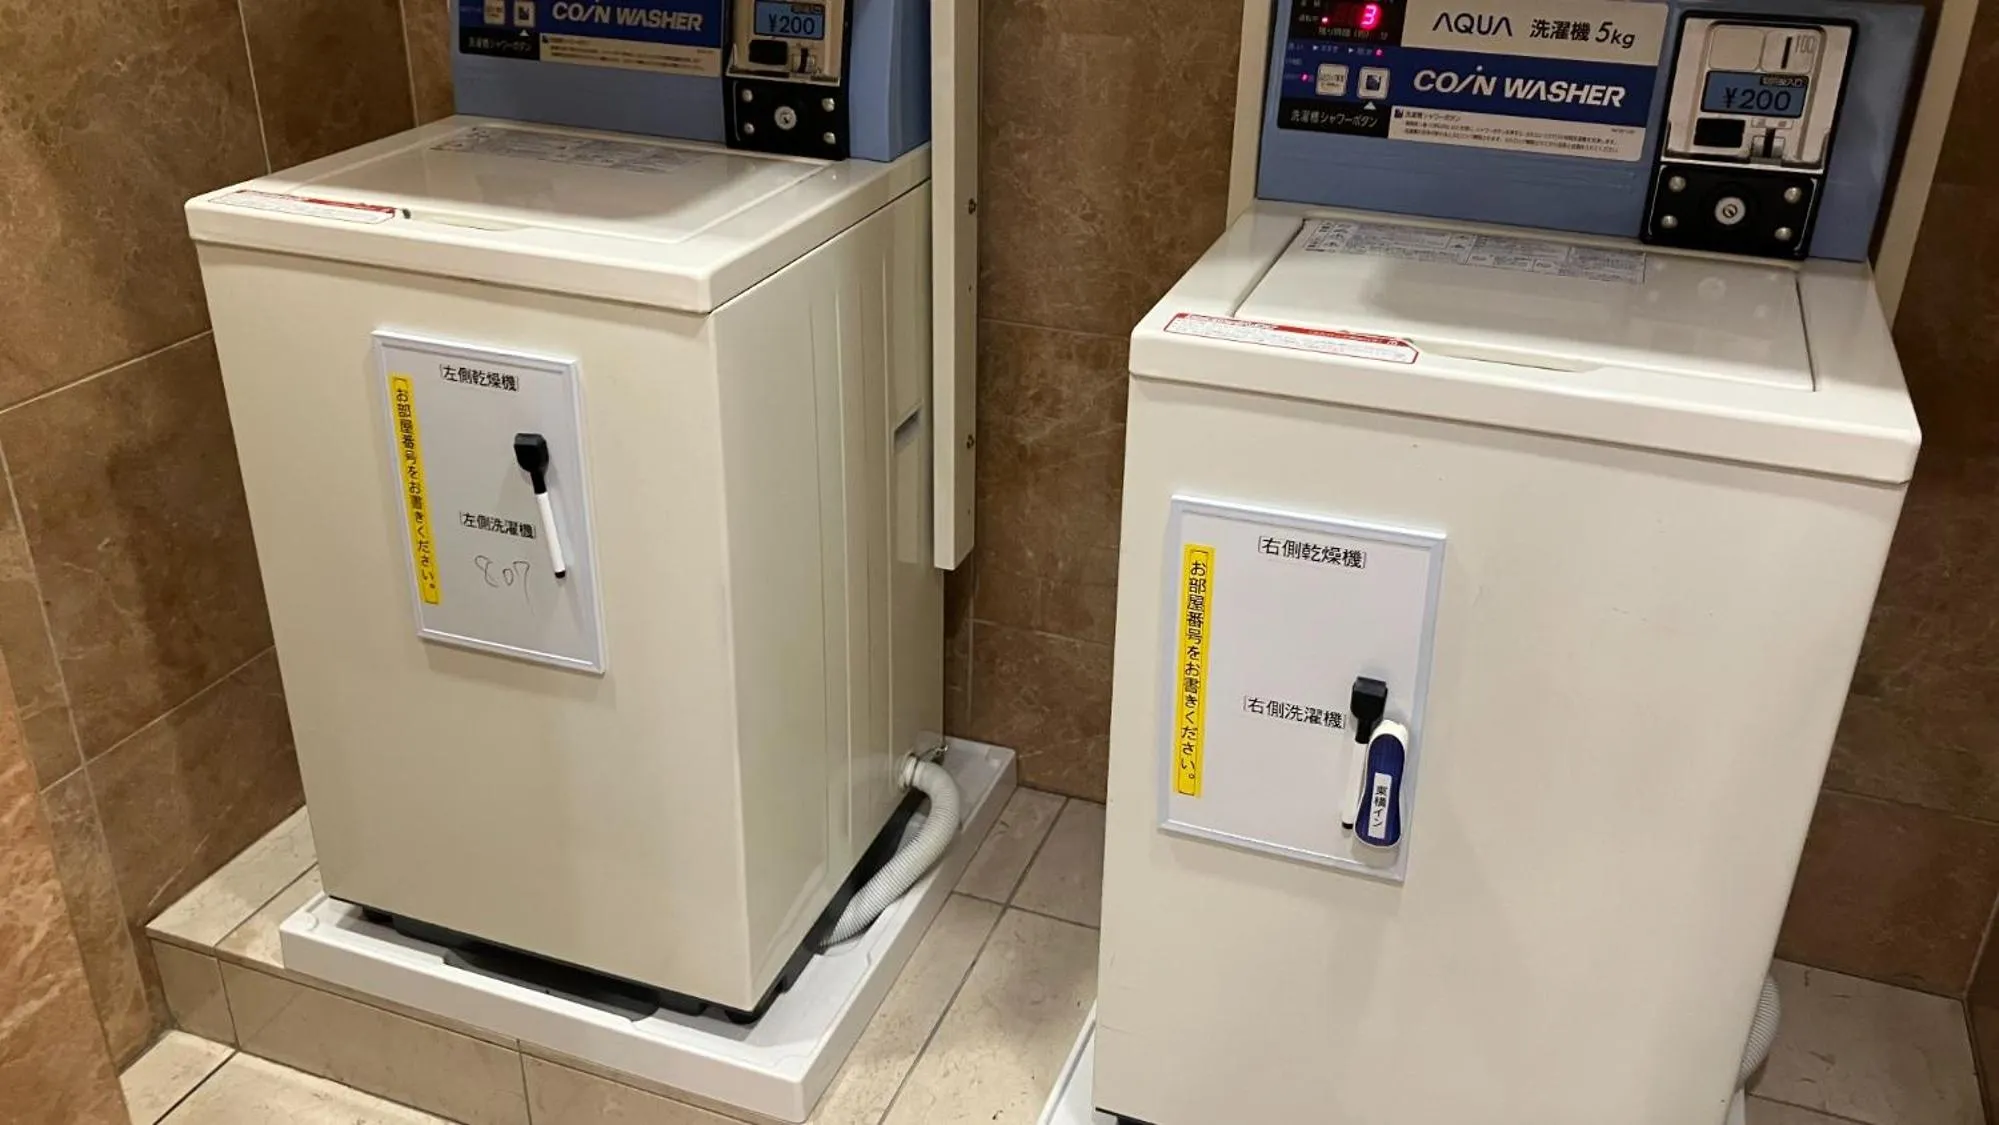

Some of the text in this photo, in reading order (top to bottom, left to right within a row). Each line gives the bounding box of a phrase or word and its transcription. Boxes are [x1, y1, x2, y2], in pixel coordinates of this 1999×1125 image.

[617, 7, 704, 31] WASHER
[769, 14, 815, 35] ¥200
[1361, 4, 1379, 26] 3
[1432, 12, 1513, 37] AQUA
[1529, 19, 1636, 48] 洗濯機 5kg
[1503, 77, 1626, 108] WASHER
[1721, 86, 1792, 111] ¥200
[443, 364, 517, 391] 左側乾燥機
[396, 388, 435, 590] お部屋番号をお書きください。
[463, 512, 534, 539] 左側洗濯機
[1261, 536, 1364, 569] 右側乾燥機
[1181, 560, 1207, 780] お部屋番号をお書きください。
[1246, 698, 1343, 729] 右側洗濯機
